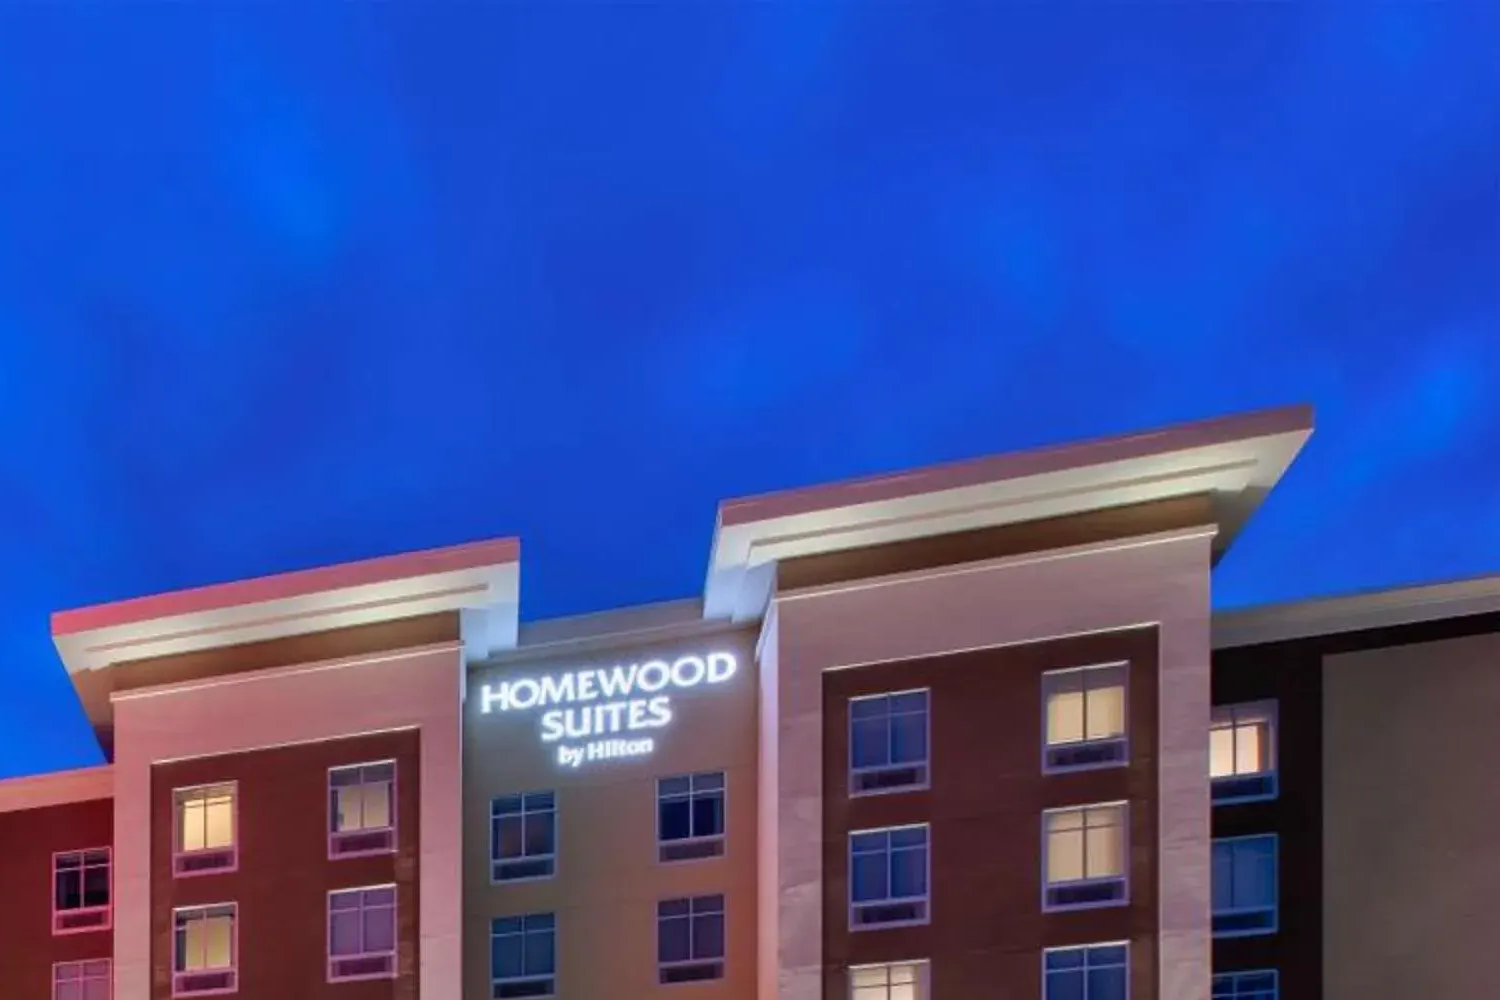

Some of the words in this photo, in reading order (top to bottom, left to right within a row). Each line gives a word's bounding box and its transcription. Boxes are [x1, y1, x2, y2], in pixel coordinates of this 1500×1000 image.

[480, 652, 737, 714] HOMEWOOD
[540, 696, 672, 741] SUITES
[557, 745, 585, 767] by
[587, 737, 654, 761] Hilton
